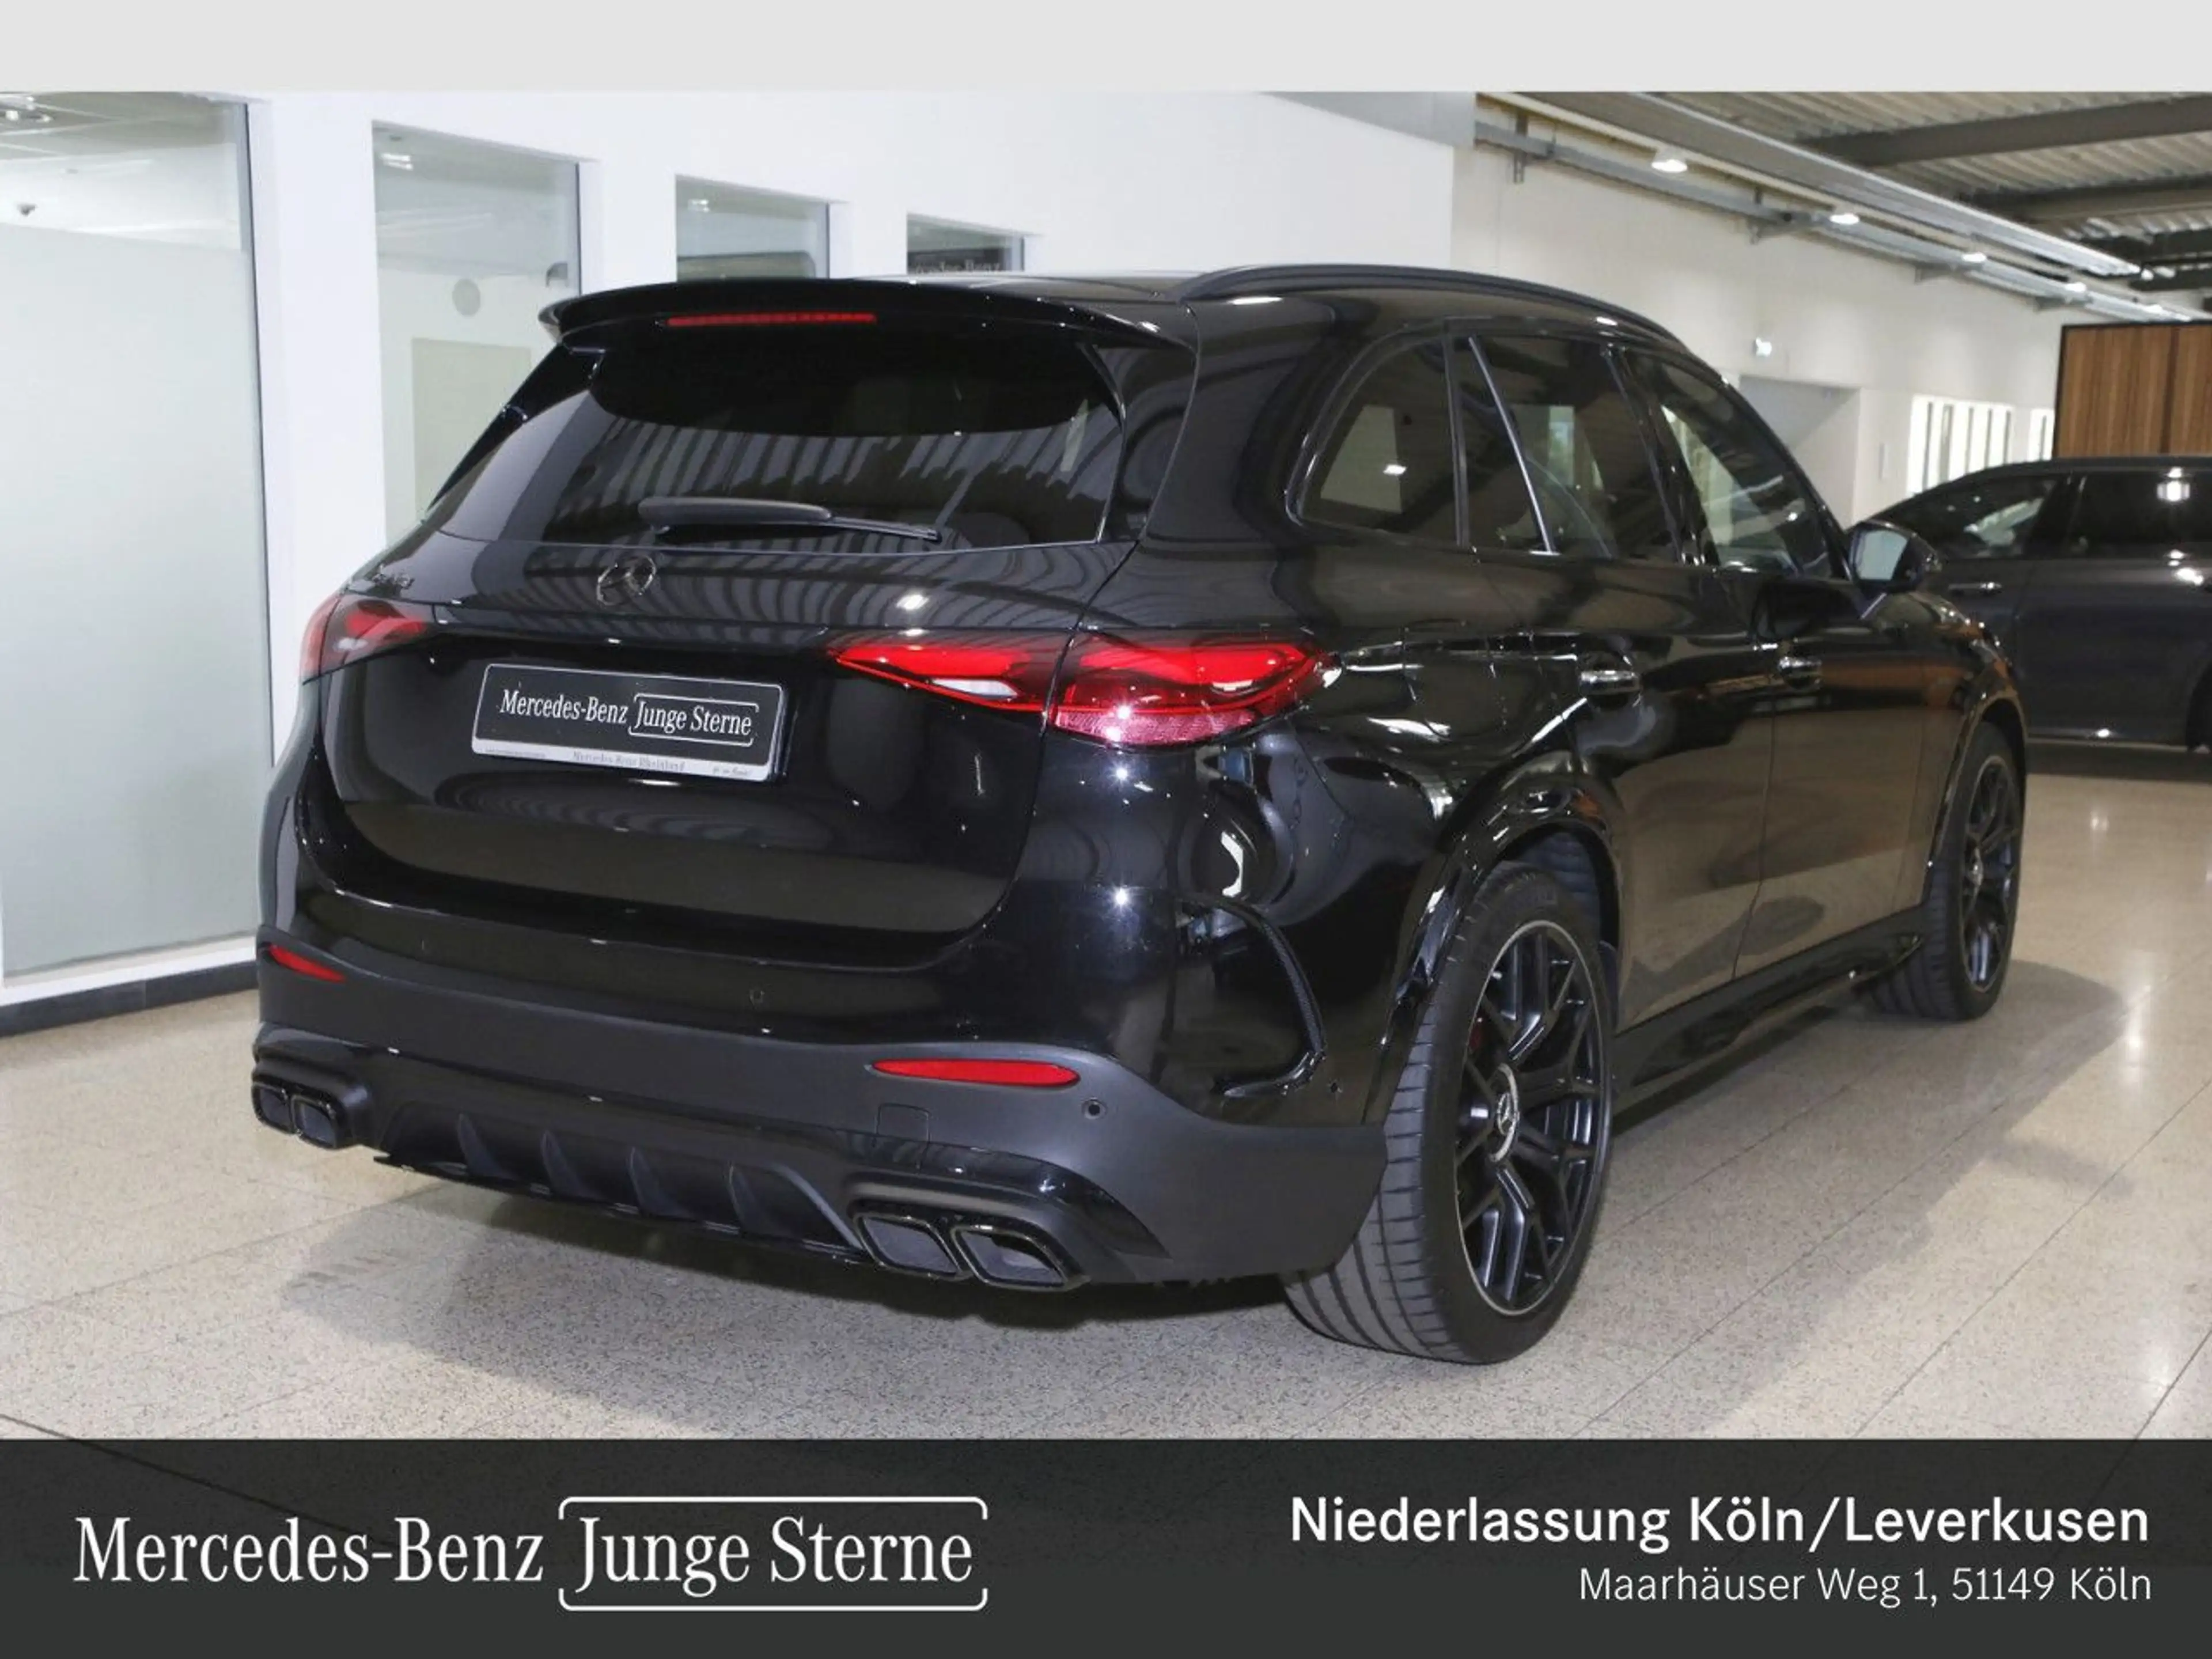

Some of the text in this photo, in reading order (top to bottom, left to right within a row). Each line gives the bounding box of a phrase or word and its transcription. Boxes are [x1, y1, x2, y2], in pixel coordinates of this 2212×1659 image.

[499, 689, 752, 736] Mercedes-Benz Junge Sterne
